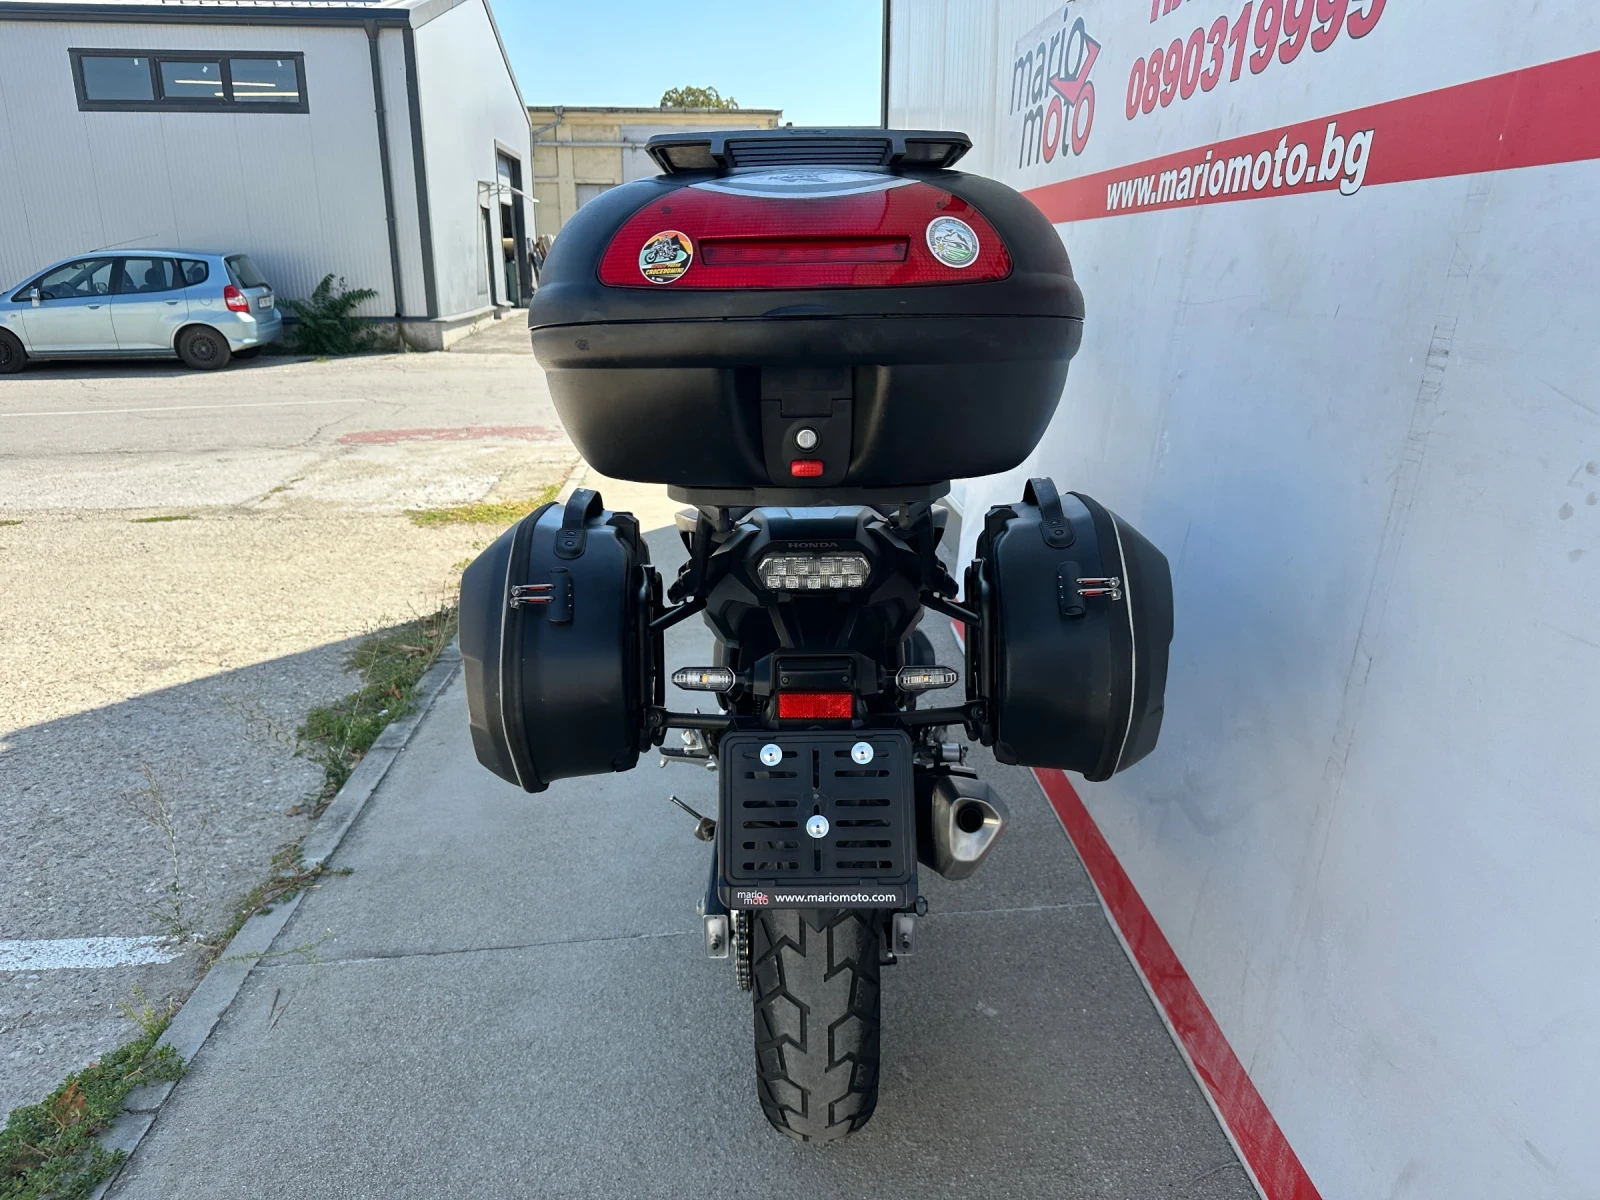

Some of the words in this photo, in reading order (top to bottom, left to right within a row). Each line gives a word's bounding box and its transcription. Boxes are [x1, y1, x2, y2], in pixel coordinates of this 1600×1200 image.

[1010, 9, 1086, 115] mario
[1018, 80, 1095, 169] moto
[1106, 121, 1375, 211] www.mariomoto.bg
[737, 890, 763, 899] mario
[743, 895, 769, 905] moto
[775, 892, 896, 903] www.mariomoto.com
